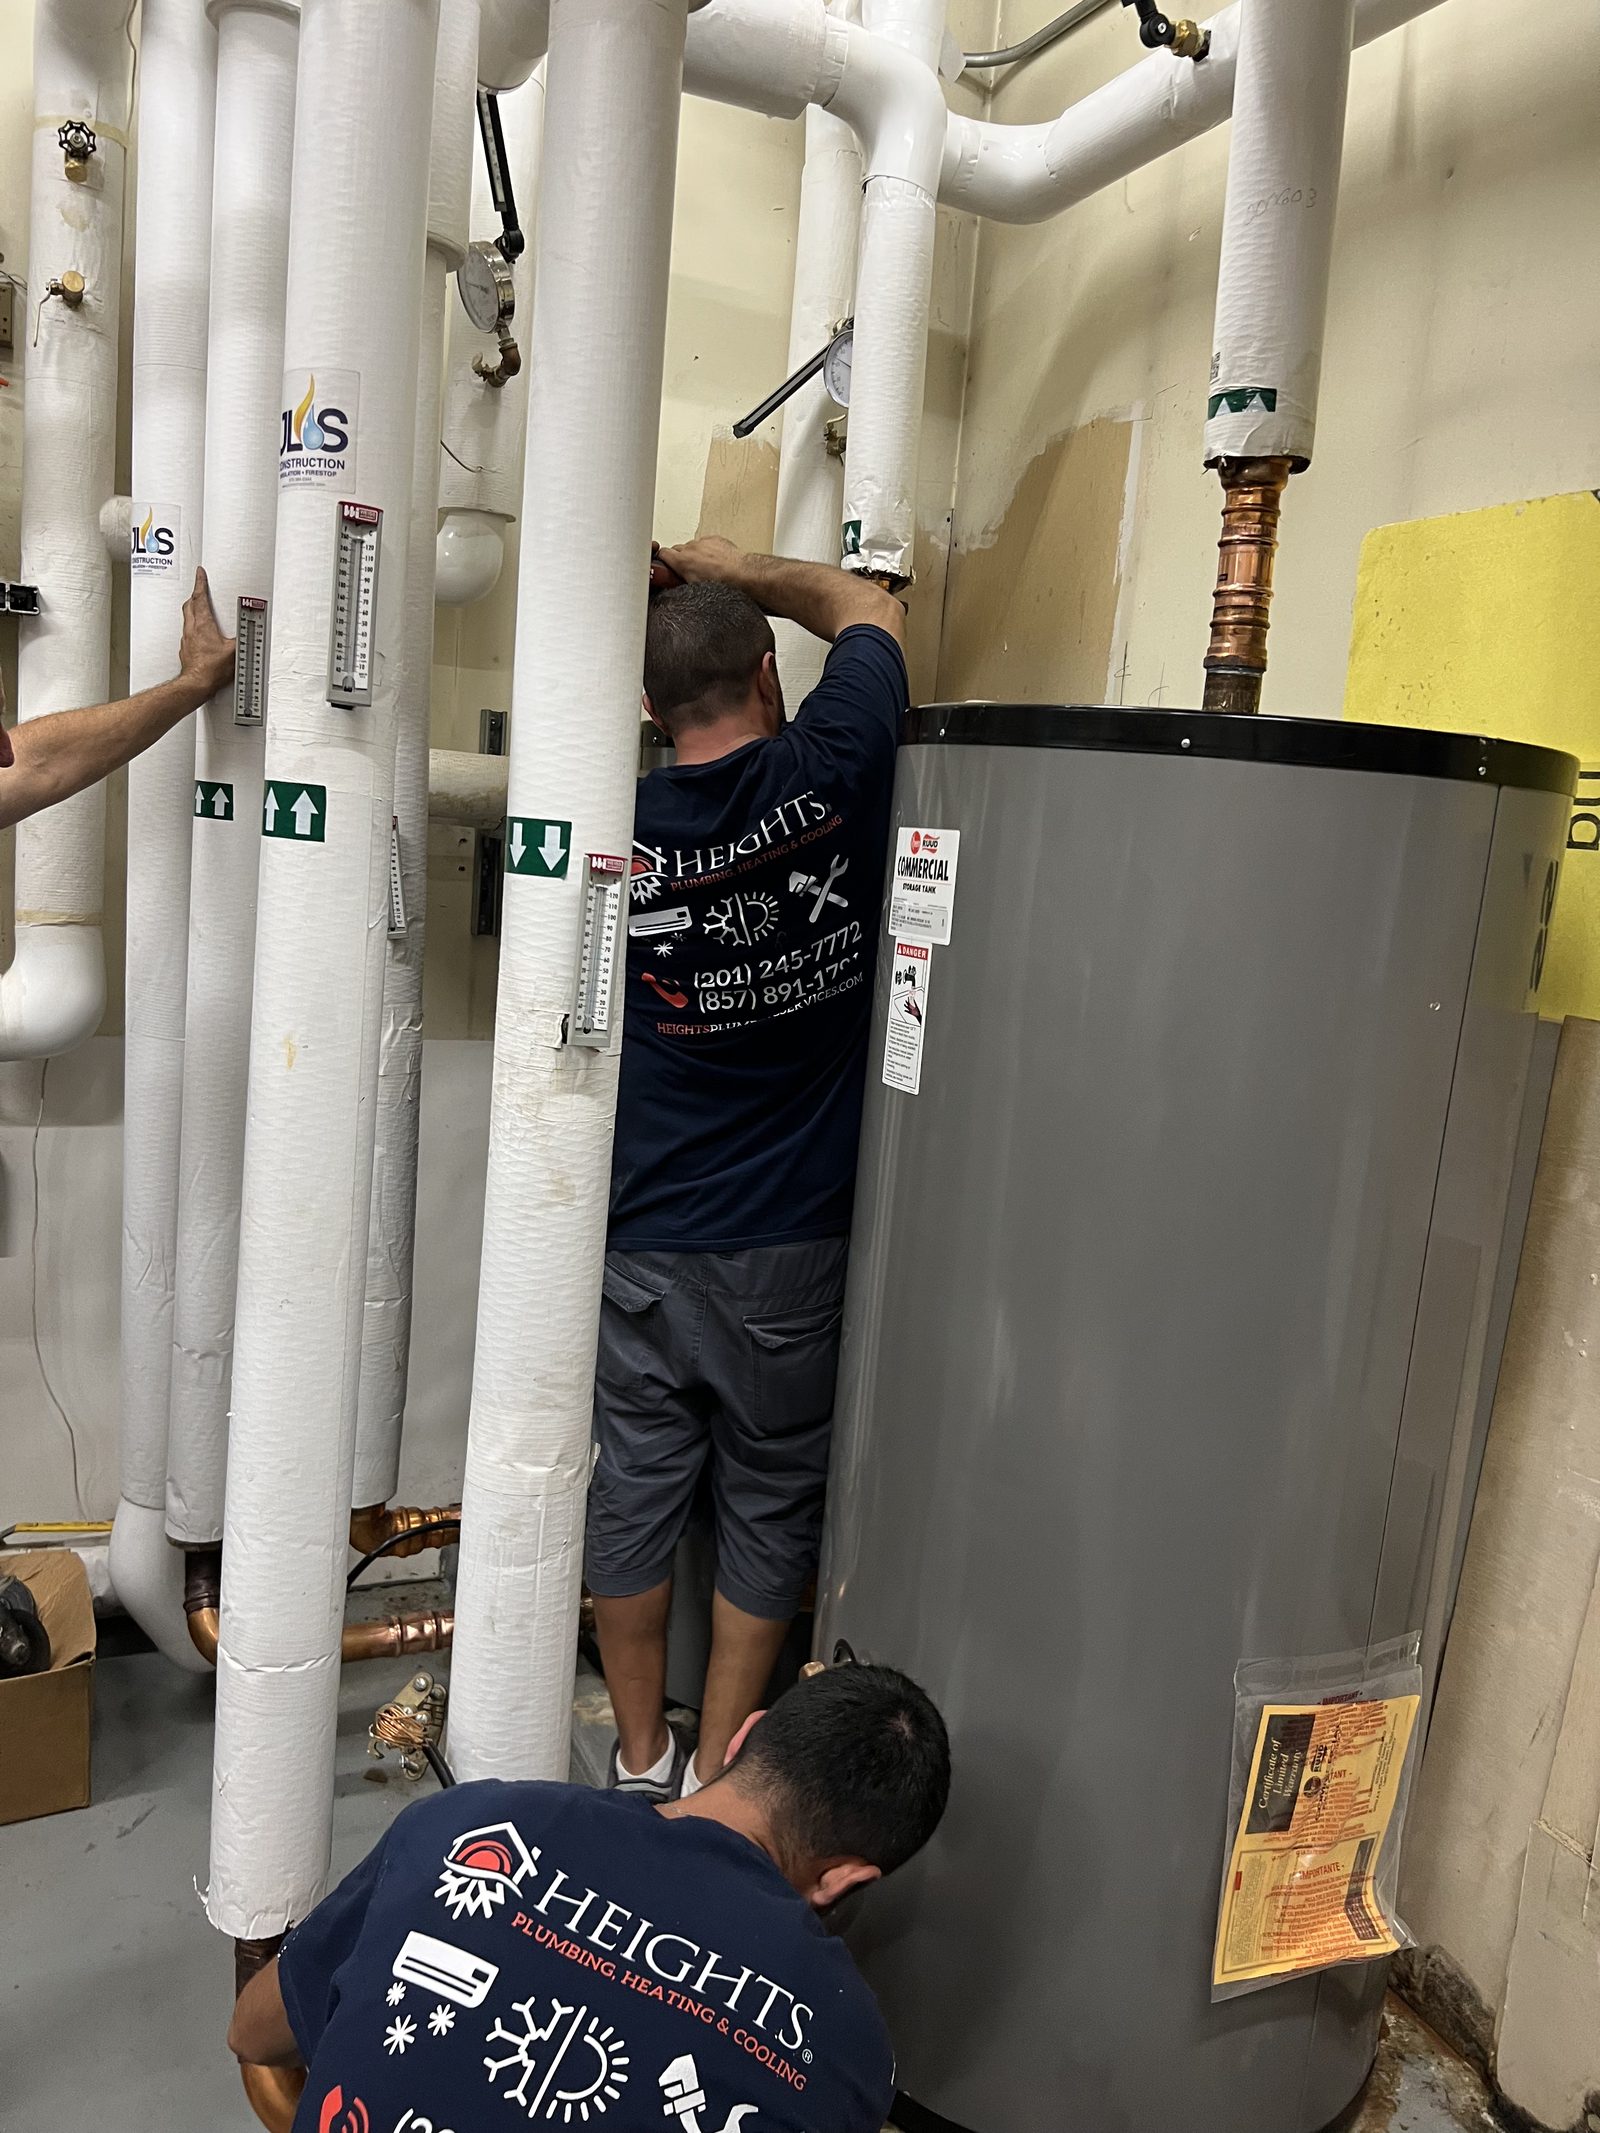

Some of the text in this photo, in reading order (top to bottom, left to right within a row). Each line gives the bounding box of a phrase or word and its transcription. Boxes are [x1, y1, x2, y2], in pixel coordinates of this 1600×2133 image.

[674, 791, 826, 877] HEIGHTS
[737, 845, 789, 874] HEATING
[790, 840, 798, 850] &
[800, 814, 844, 844] COOLING
[897, 856, 949, 881] COMMERCIAL
[902, 882, 936, 894] STORAGE TANK
[694, 921, 863, 989] (201) 245-7772
[903, 947, 927, 959] DANGER
[699, 988, 757, 1014] (857)
[1259, 1737, 1281, 1809] Certificate of
[1273, 1753, 1289, 1794] Limited
[533, 1869, 814, 2051] HEIGHTS
[511, 1912, 807, 2092] PLUMBING, HEATING & COOLING
